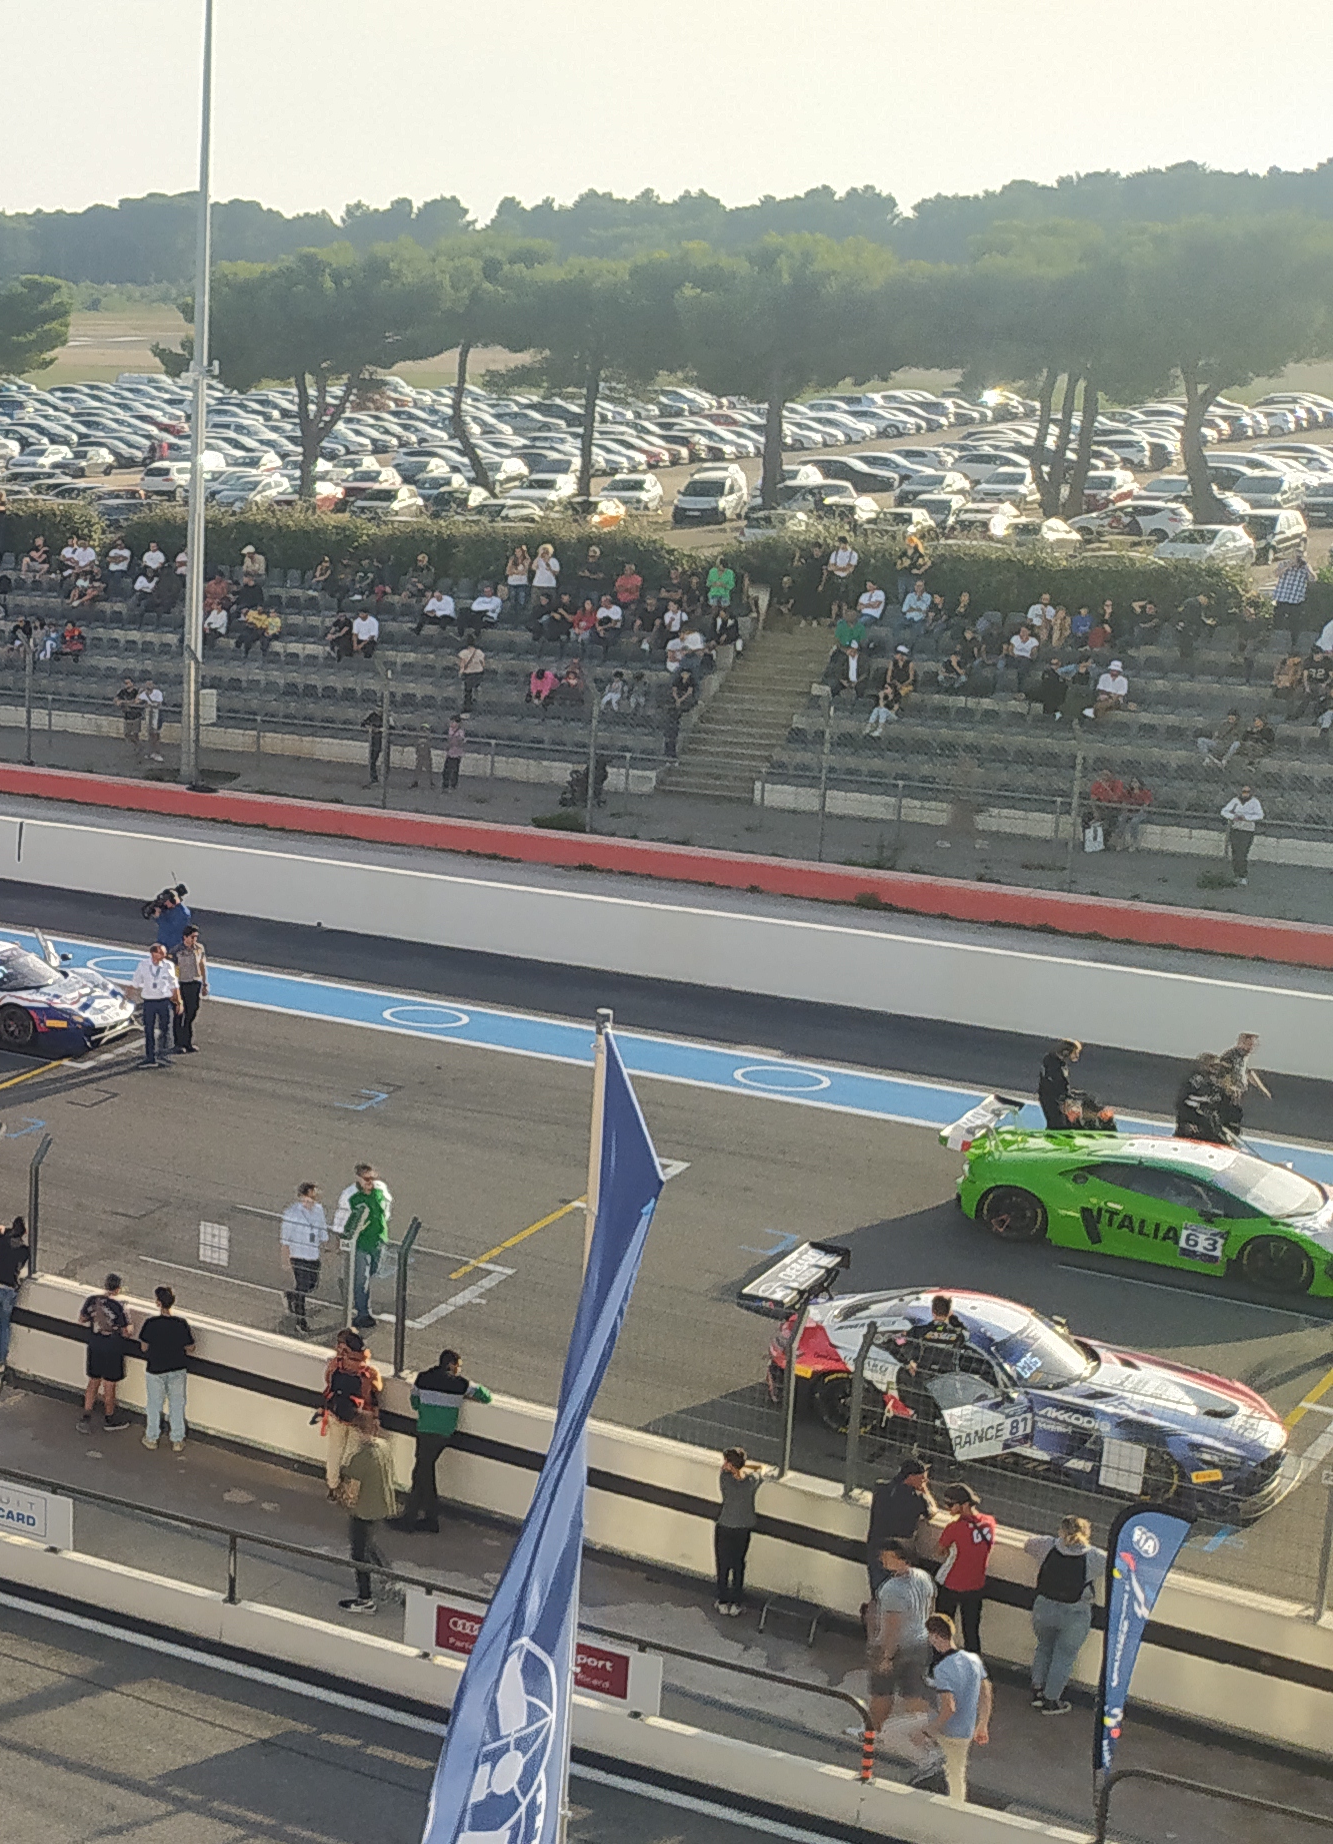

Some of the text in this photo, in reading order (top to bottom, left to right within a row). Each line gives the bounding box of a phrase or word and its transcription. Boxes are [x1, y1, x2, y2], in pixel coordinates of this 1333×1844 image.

[1185, 1232, 1219, 1252] 63
[954, 1423, 1005, 1449] RANCE
[1133, 1526, 1159, 1557] FIA
[576, 1657, 613, 1673] port
